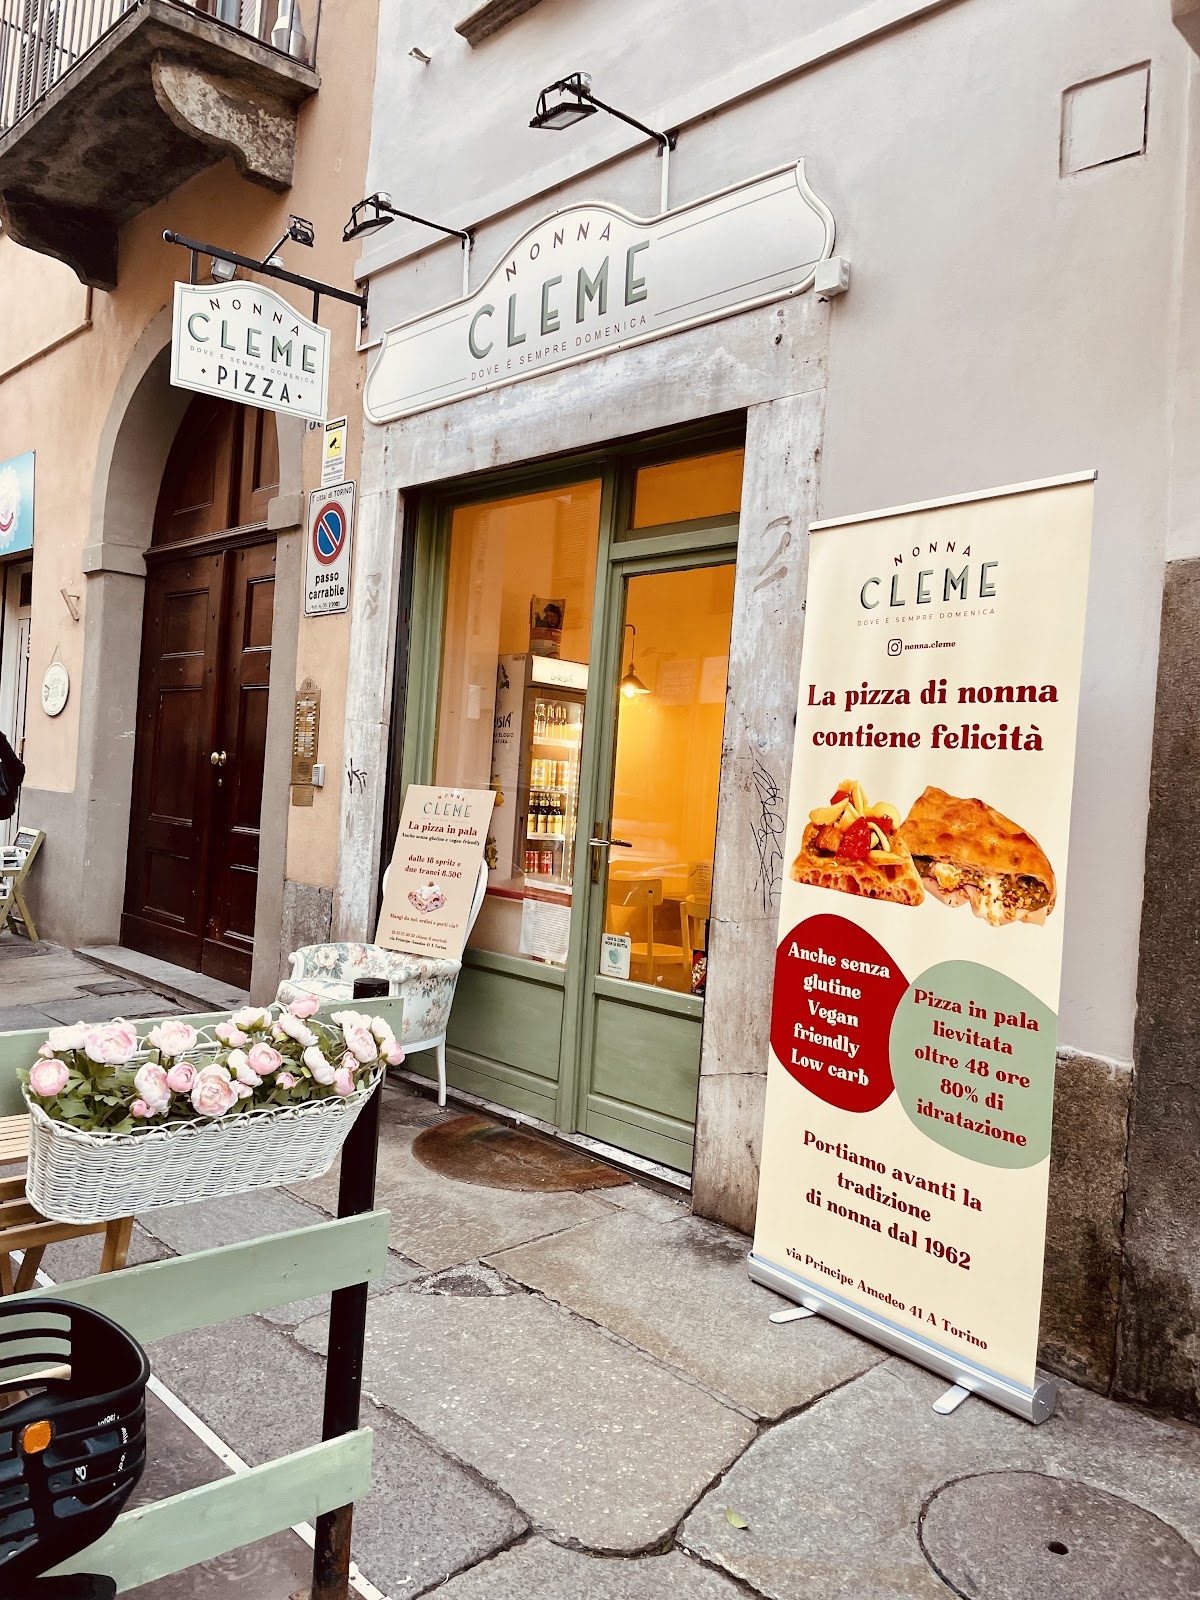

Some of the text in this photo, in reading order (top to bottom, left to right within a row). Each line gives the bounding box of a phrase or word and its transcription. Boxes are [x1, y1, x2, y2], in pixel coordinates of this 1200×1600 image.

[505, 221, 611, 282] NONNA
[468, 239, 650, 360] CLEME
[209, 298, 299, 337] NONNA
[187, 312, 317, 374] CLEME
[471, 364, 499, 381] DOVE
[519, 341, 567, 365] SEMPRE
[575, 314, 646, 347] DOMENICA
[190, 345, 214, 357] DOVE
[230, 356, 265, 371] SEMPRE
[270, 368, 315, 385] DOMENICA
[217, 365, 290, 403] PIZZA
[334, 486, 353, 498] TORINO
[894, 541, 972, 567] NONNA
[309, 585, 344, 600] carrabile
[315, 571, 339, 586] passo
[860, 561, 999, 610] CLEME
[857, 618, 880, 627] DOVE
[895, 613, 933, 623] SEMPRE
[939, 608, 996, 619] DOMENICA
[904, 640, 956, 651] nonna.cleme
[807, 679, 1059, 712] La pizza di nonna
[812, 723, 1044, 752] contiene felicità
[423, 802, 472, 818] CLEME
[438, 793, 465, 802] NONNA
[408, 821, 477, 837] La pizza in pala
[405, 865, 417, 873] due
[419, 867, 440, 876] tranci
[408, 854, 425, 863] dalle
[436, 859, 456, 867] spritz
[788, 942, 891, 979] Anche senza
[803, 974, 862, 1000] glutine
[808, 999, 859, 1027] Vegan
[914, 988, 1040, 1032] Pizza in pala
[793, 1023, 860, 1058] friendly
[932, 1020, 1013, 1055] lievitata
[791, 1048, 870, 1087] Low carb
[914, 1045, 1031, 1089] oltre 48 ore
[940, 1078, 1004, 1111] 80% di
[916, 1098, 1027, 1147] idratazione
[803, 1129, 983, 1212] Portiamo avanti la
[837, 1172, 932, 1222] tradizione
[805, 1188, 971, 1271] di nonna dal 1962
[785, 1247, 988, 1350] via Principe Amedeo 41 A Torino
